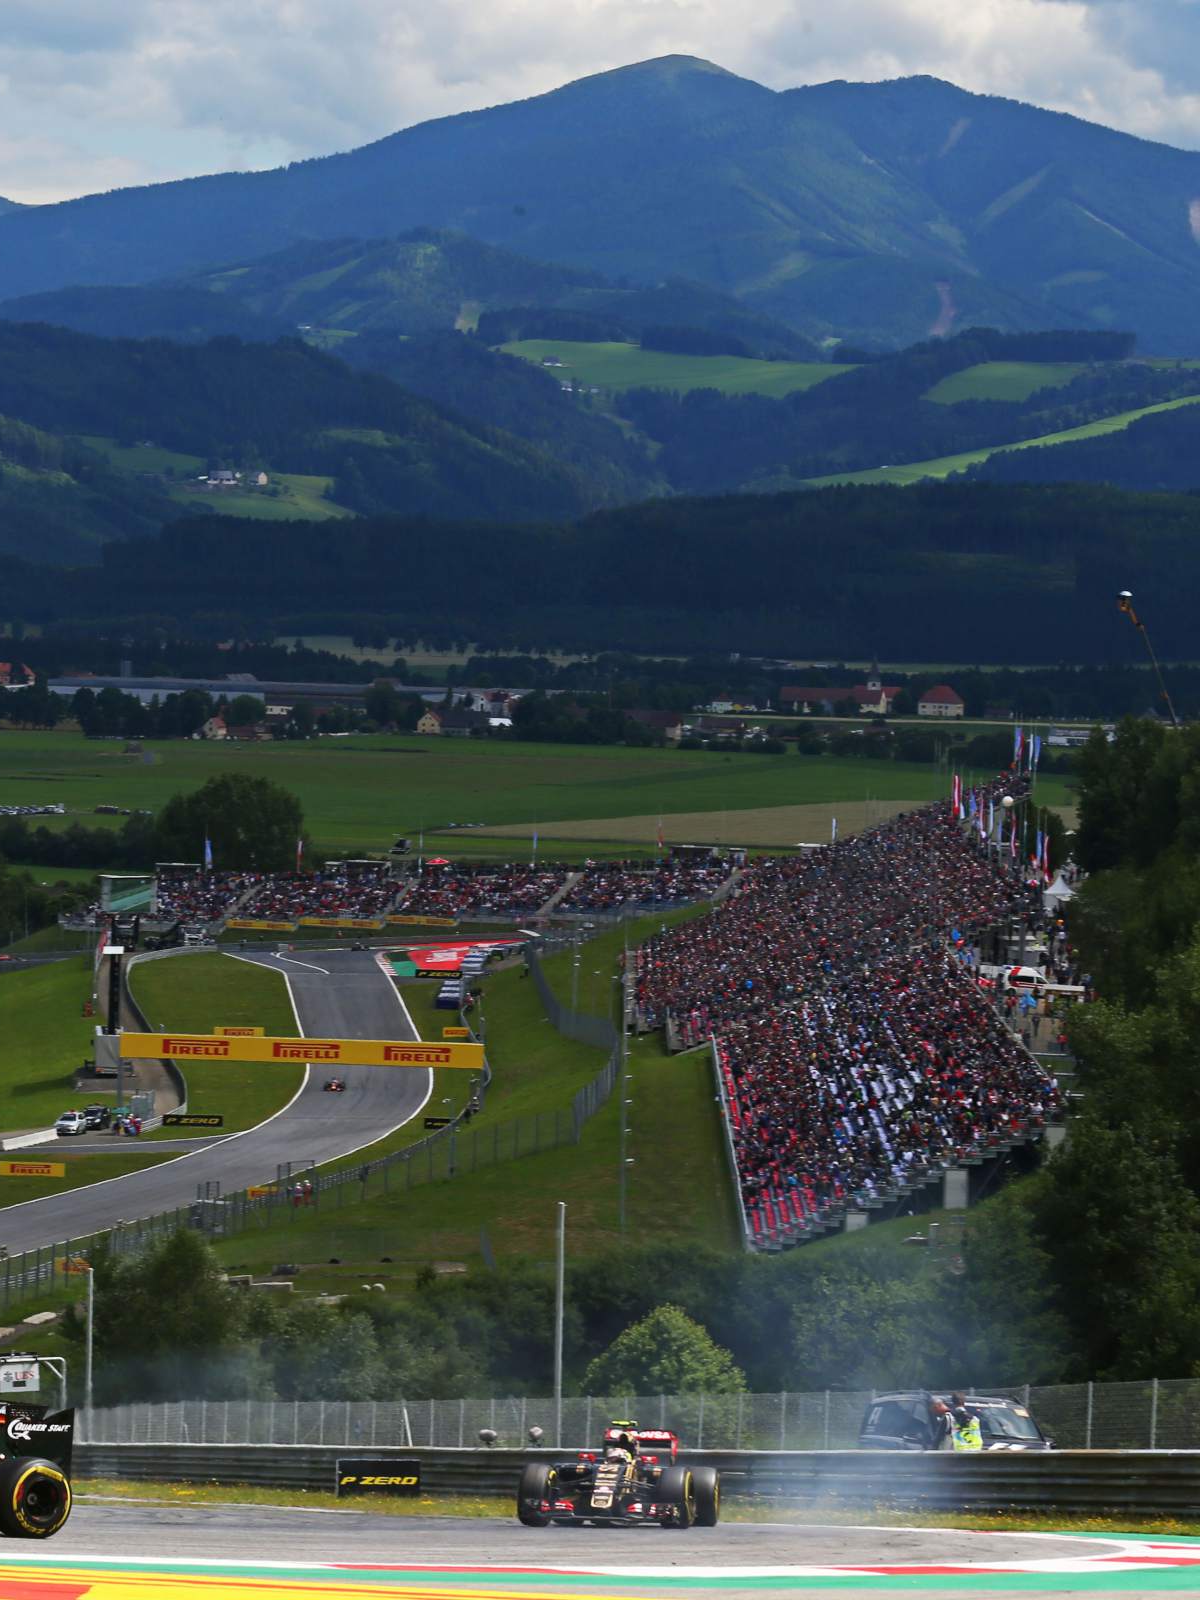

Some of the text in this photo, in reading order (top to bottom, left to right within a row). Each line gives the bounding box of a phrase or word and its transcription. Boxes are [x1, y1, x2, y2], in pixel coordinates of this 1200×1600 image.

[162, 1038, 229, 1056] PIRELLI
[272, 1042, 340, 1059] PIRELLI
[384, 1045, 451, 1063] PIRELLI
[179, 1117, 220, 1125] ZERO
[10, 1164, 51, 1174] PIRELLI
[341, 1476, 418, 1485] P ZERO
